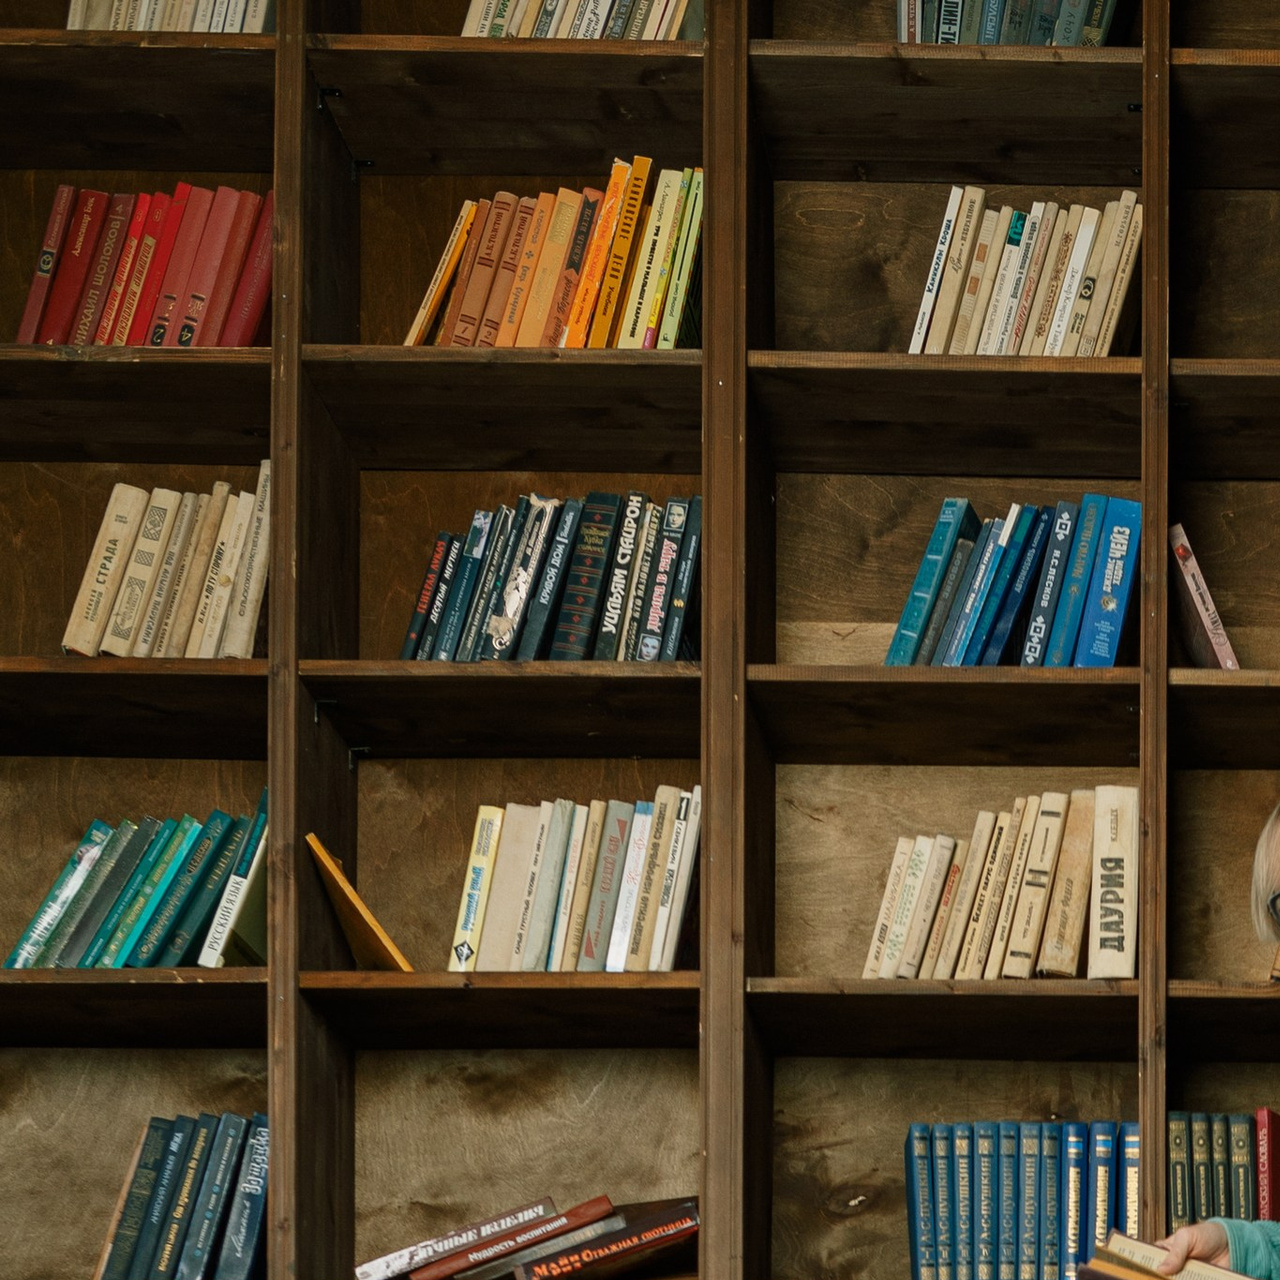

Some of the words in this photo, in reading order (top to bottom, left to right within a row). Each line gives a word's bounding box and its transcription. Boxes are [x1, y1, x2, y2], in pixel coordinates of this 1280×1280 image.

[619, 177, 643, 240] БАНКОВСКОЕ
[91, 220, 121, 285] ШОЛОХОВ
[609, 254, 624, 280] ДЕЛО
[539, 568, 559, 604] КРИВОЙ
[549, 544, 564, 567] ДОМ
[1040, 550, 1061, 608] Н.С.ЛЕСКОВ
[1100, 858, 1124, 952] ДАУРИЯ
